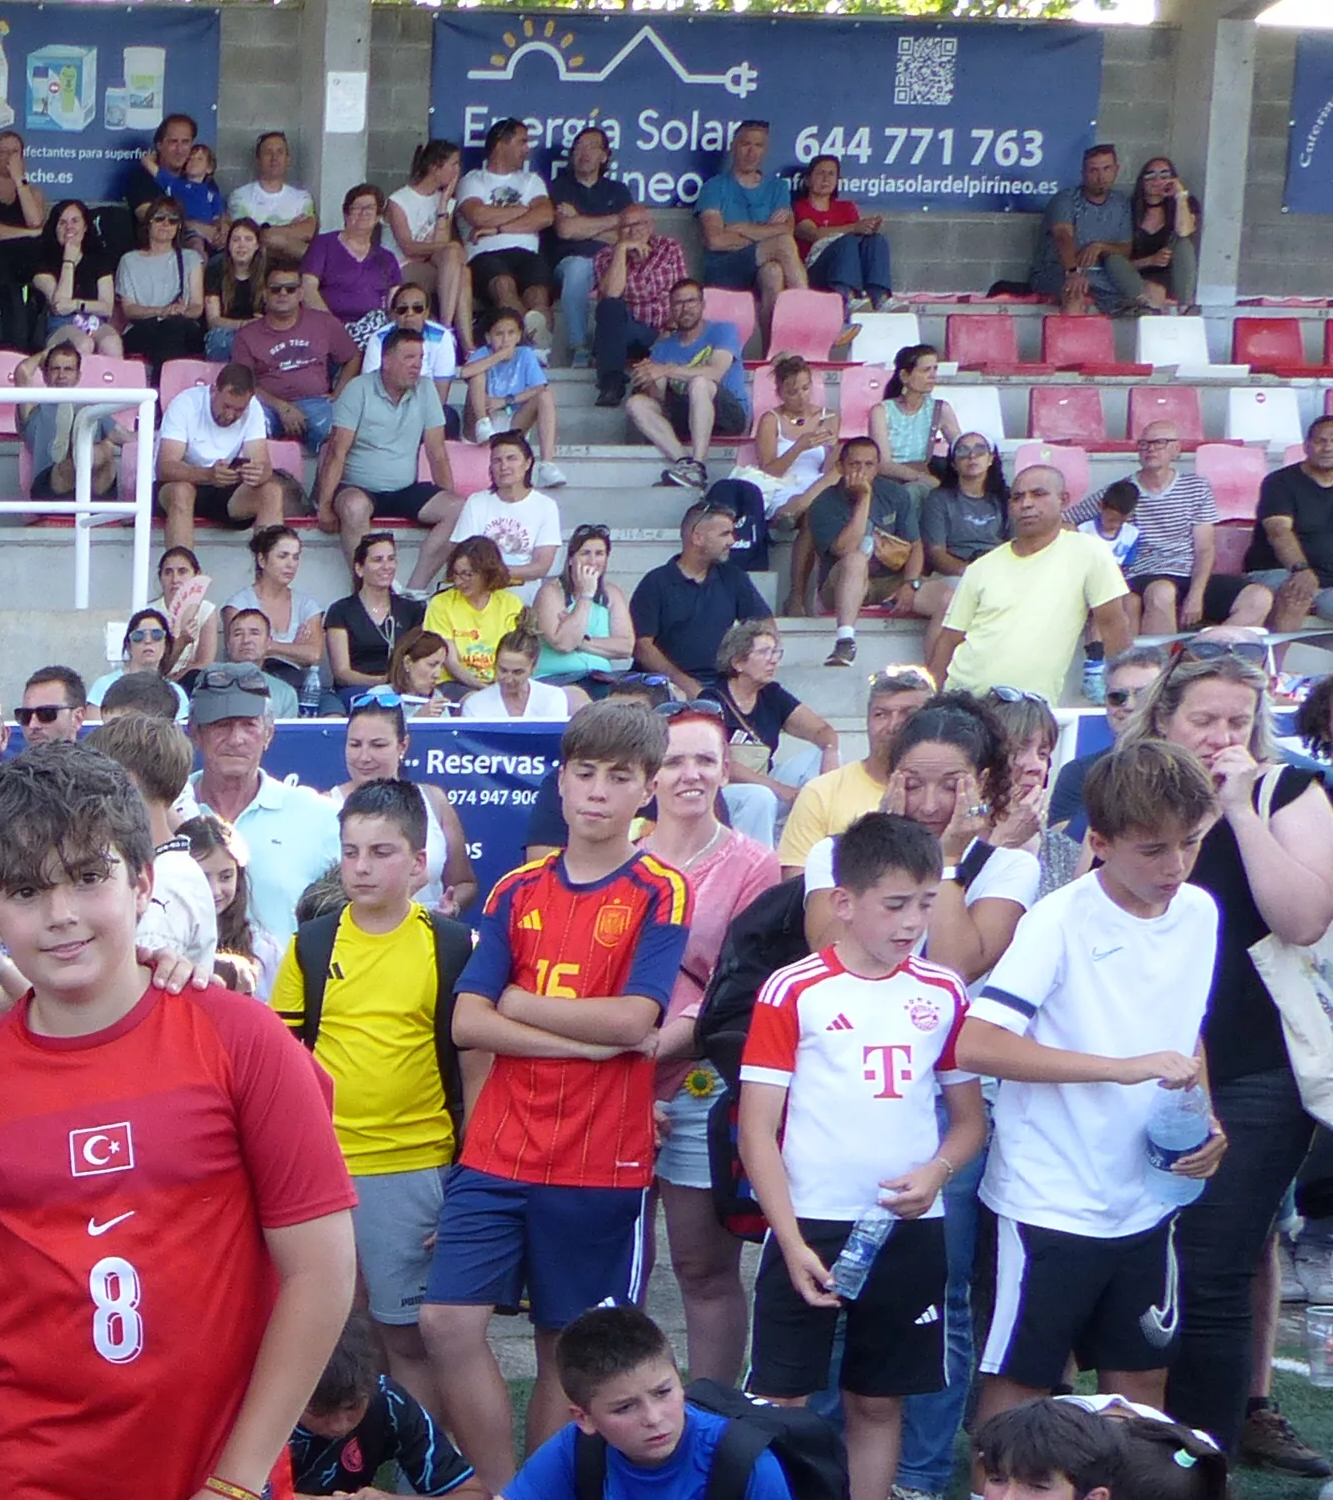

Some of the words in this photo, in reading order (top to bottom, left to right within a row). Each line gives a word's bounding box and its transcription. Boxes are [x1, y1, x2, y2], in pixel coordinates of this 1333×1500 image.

[464, 105, 621, 157] Eergía
[636, 109, 743, 151] Solar
[794, 125, 873, 165] 644
[883, 127, 955, 165] 771
[970, 129, 1044, 168] 763
[78, 149, 103, 161] para
[426, 749, 545, 776] Reservas
[447, 789, 477, 806] 974
[480, 789, 508, 806] 947
[862, 1044, 912, 1099] T
[89, 1256, 143, 1364] 8
